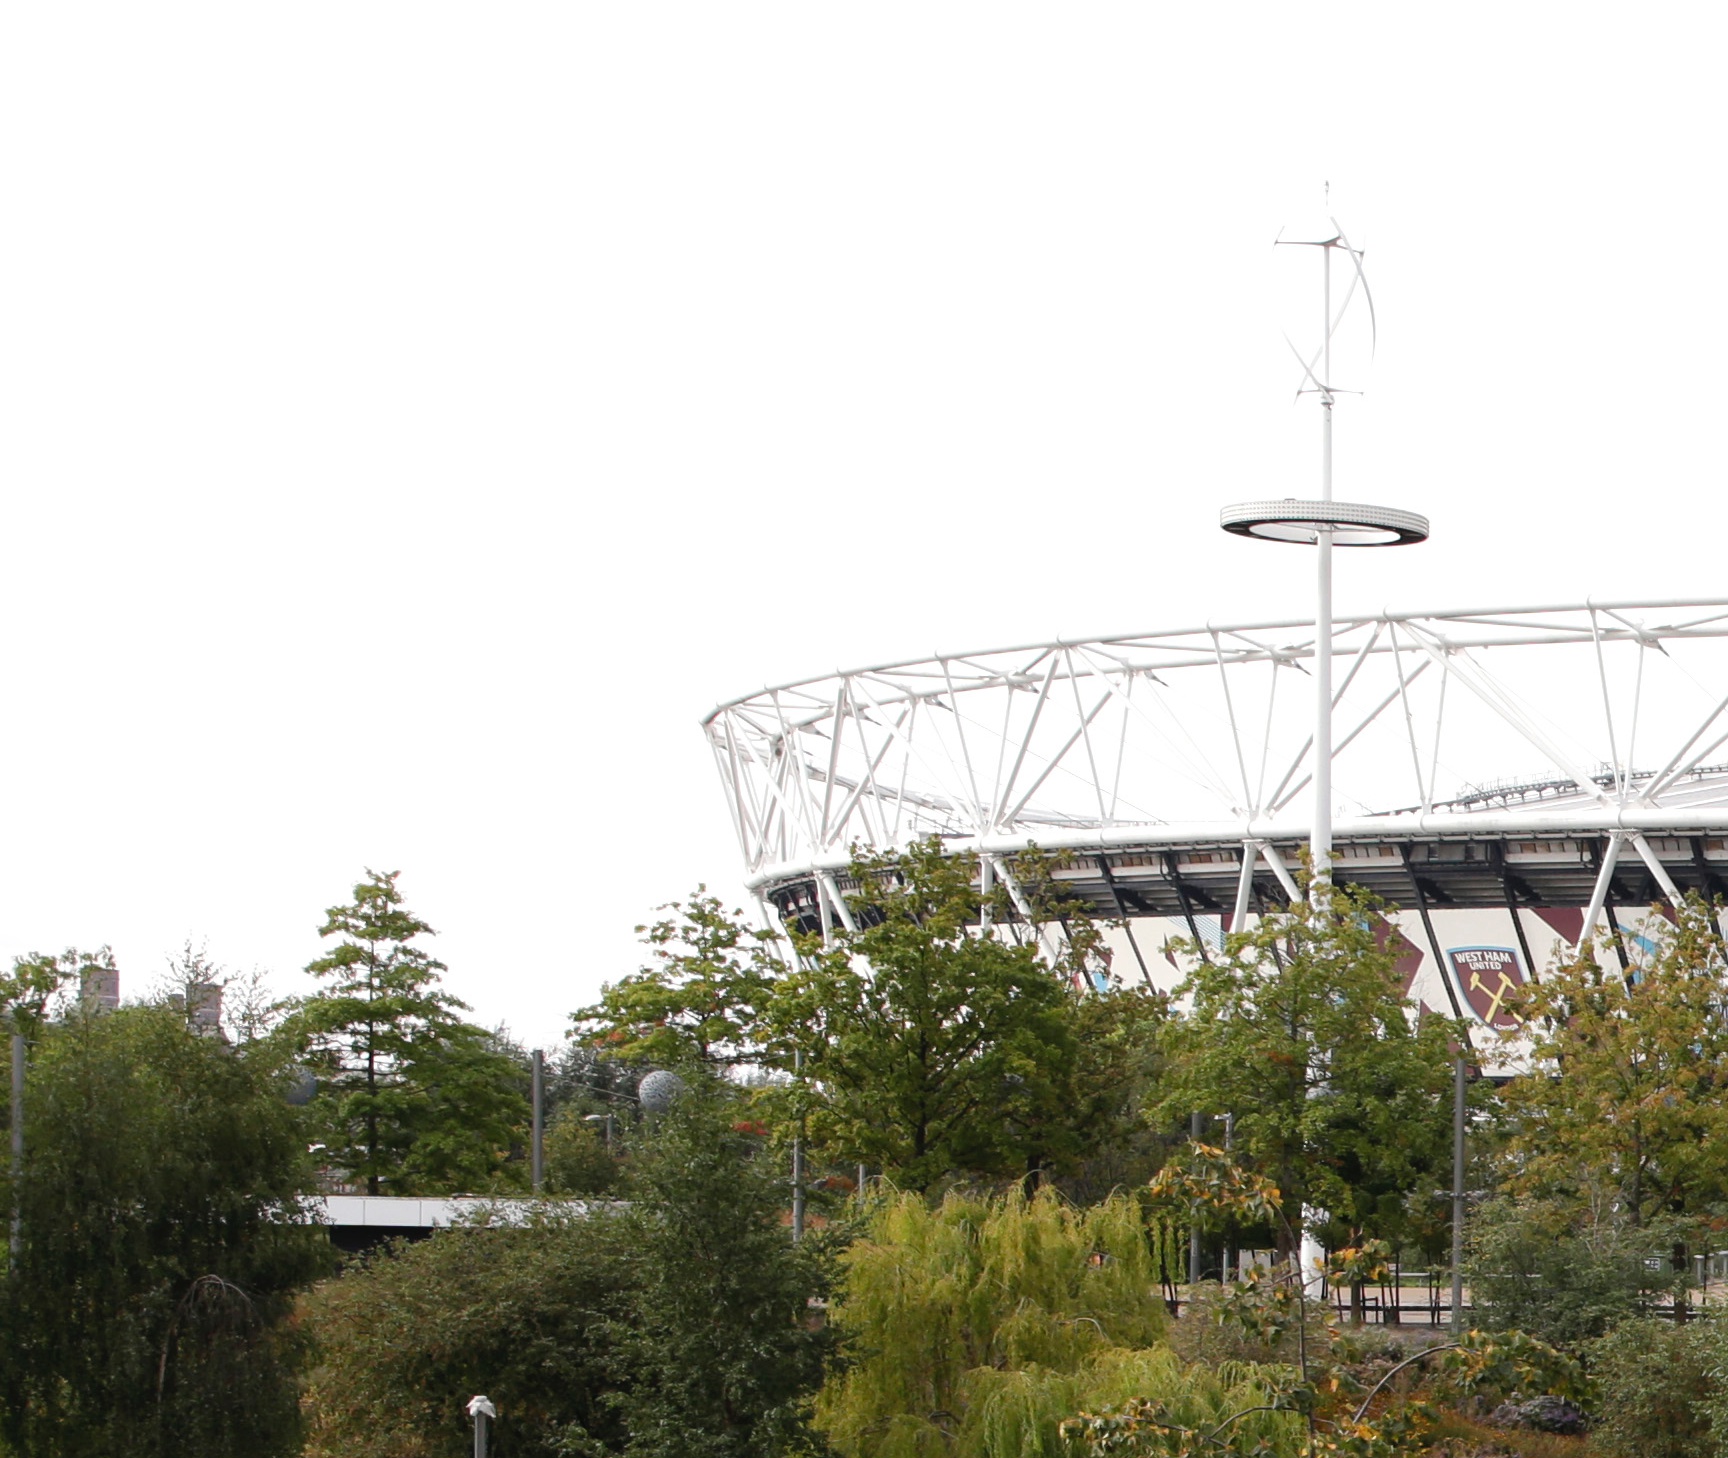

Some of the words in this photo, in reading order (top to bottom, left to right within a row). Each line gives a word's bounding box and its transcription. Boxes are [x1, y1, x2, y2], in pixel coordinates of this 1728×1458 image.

[1455, 952, 1482, 963] WEST
[1484, 951, 1512, 963] HAM
[1469, 961, 1502, 970] UNITED
